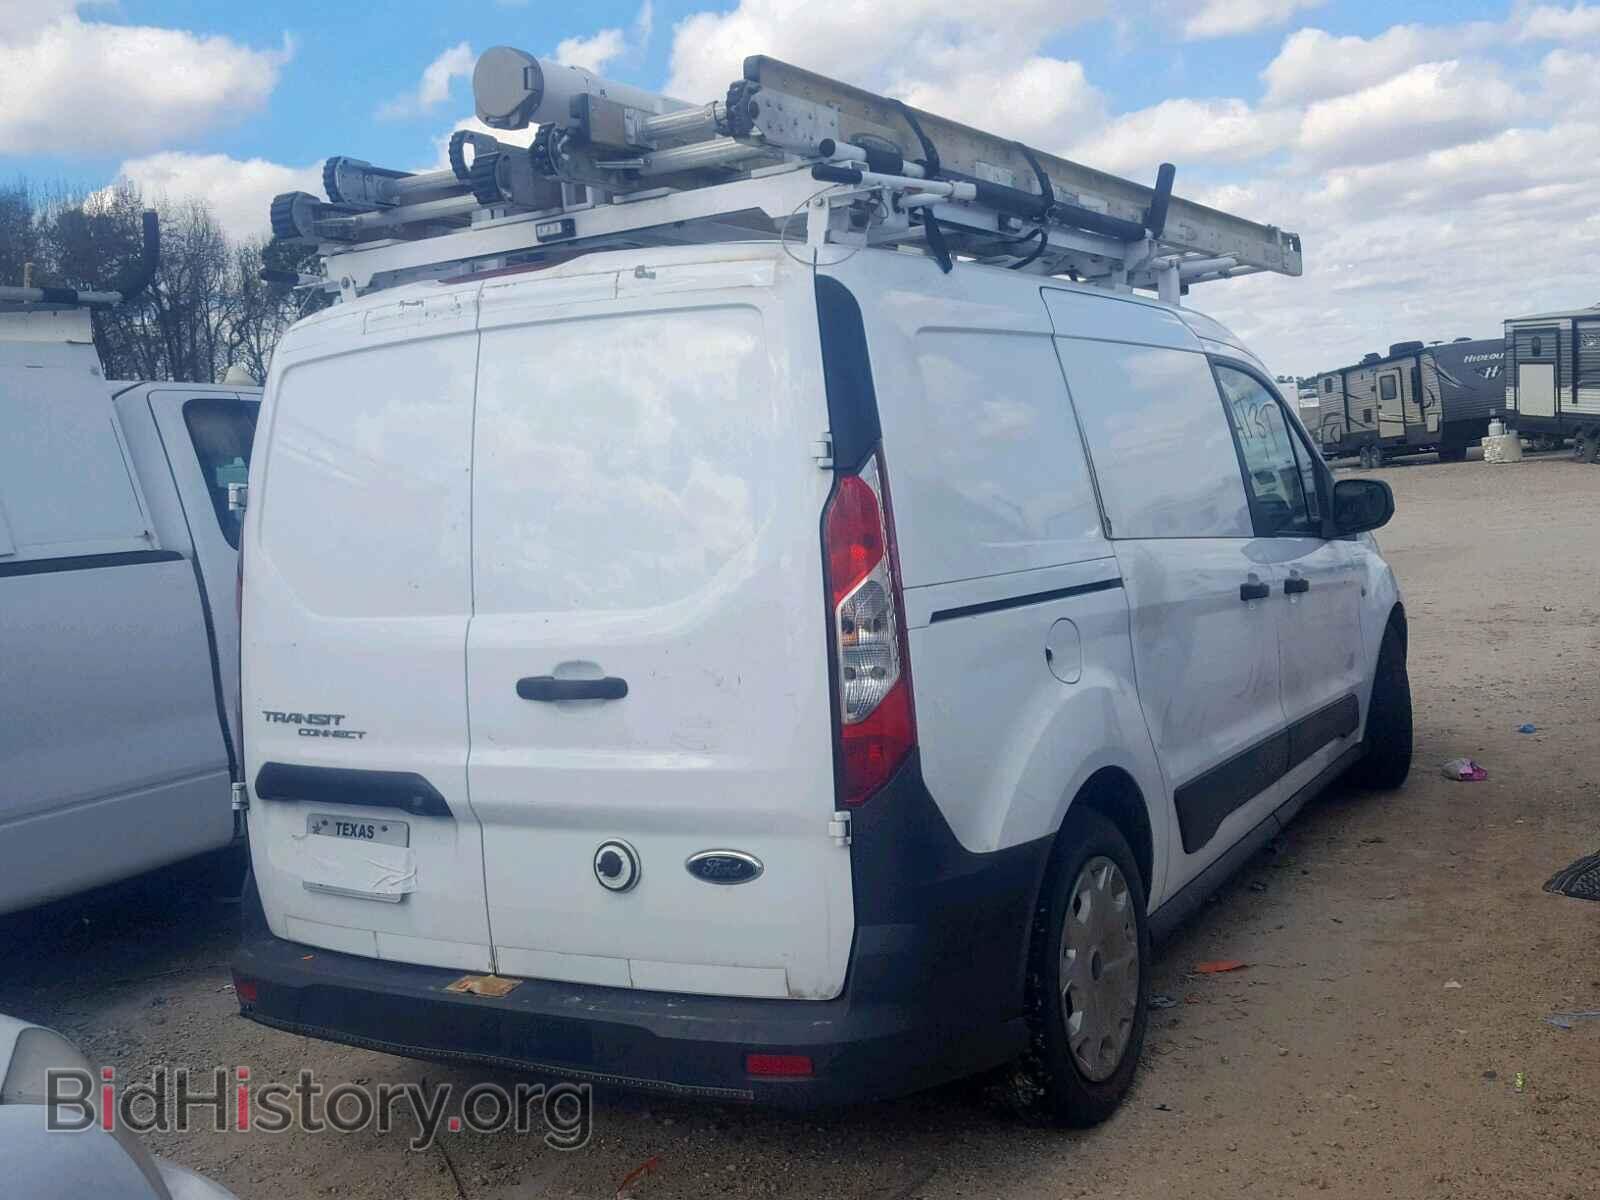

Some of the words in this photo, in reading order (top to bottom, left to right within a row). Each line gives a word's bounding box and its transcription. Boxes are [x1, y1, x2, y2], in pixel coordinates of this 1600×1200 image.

[1463, 352, 1505, 363] HIDEOU
[262, 710, 346, 726] TRANSIT
[298, 727, 367, 740] CONNECT
[336, 821, 375, 840] TEXAS
